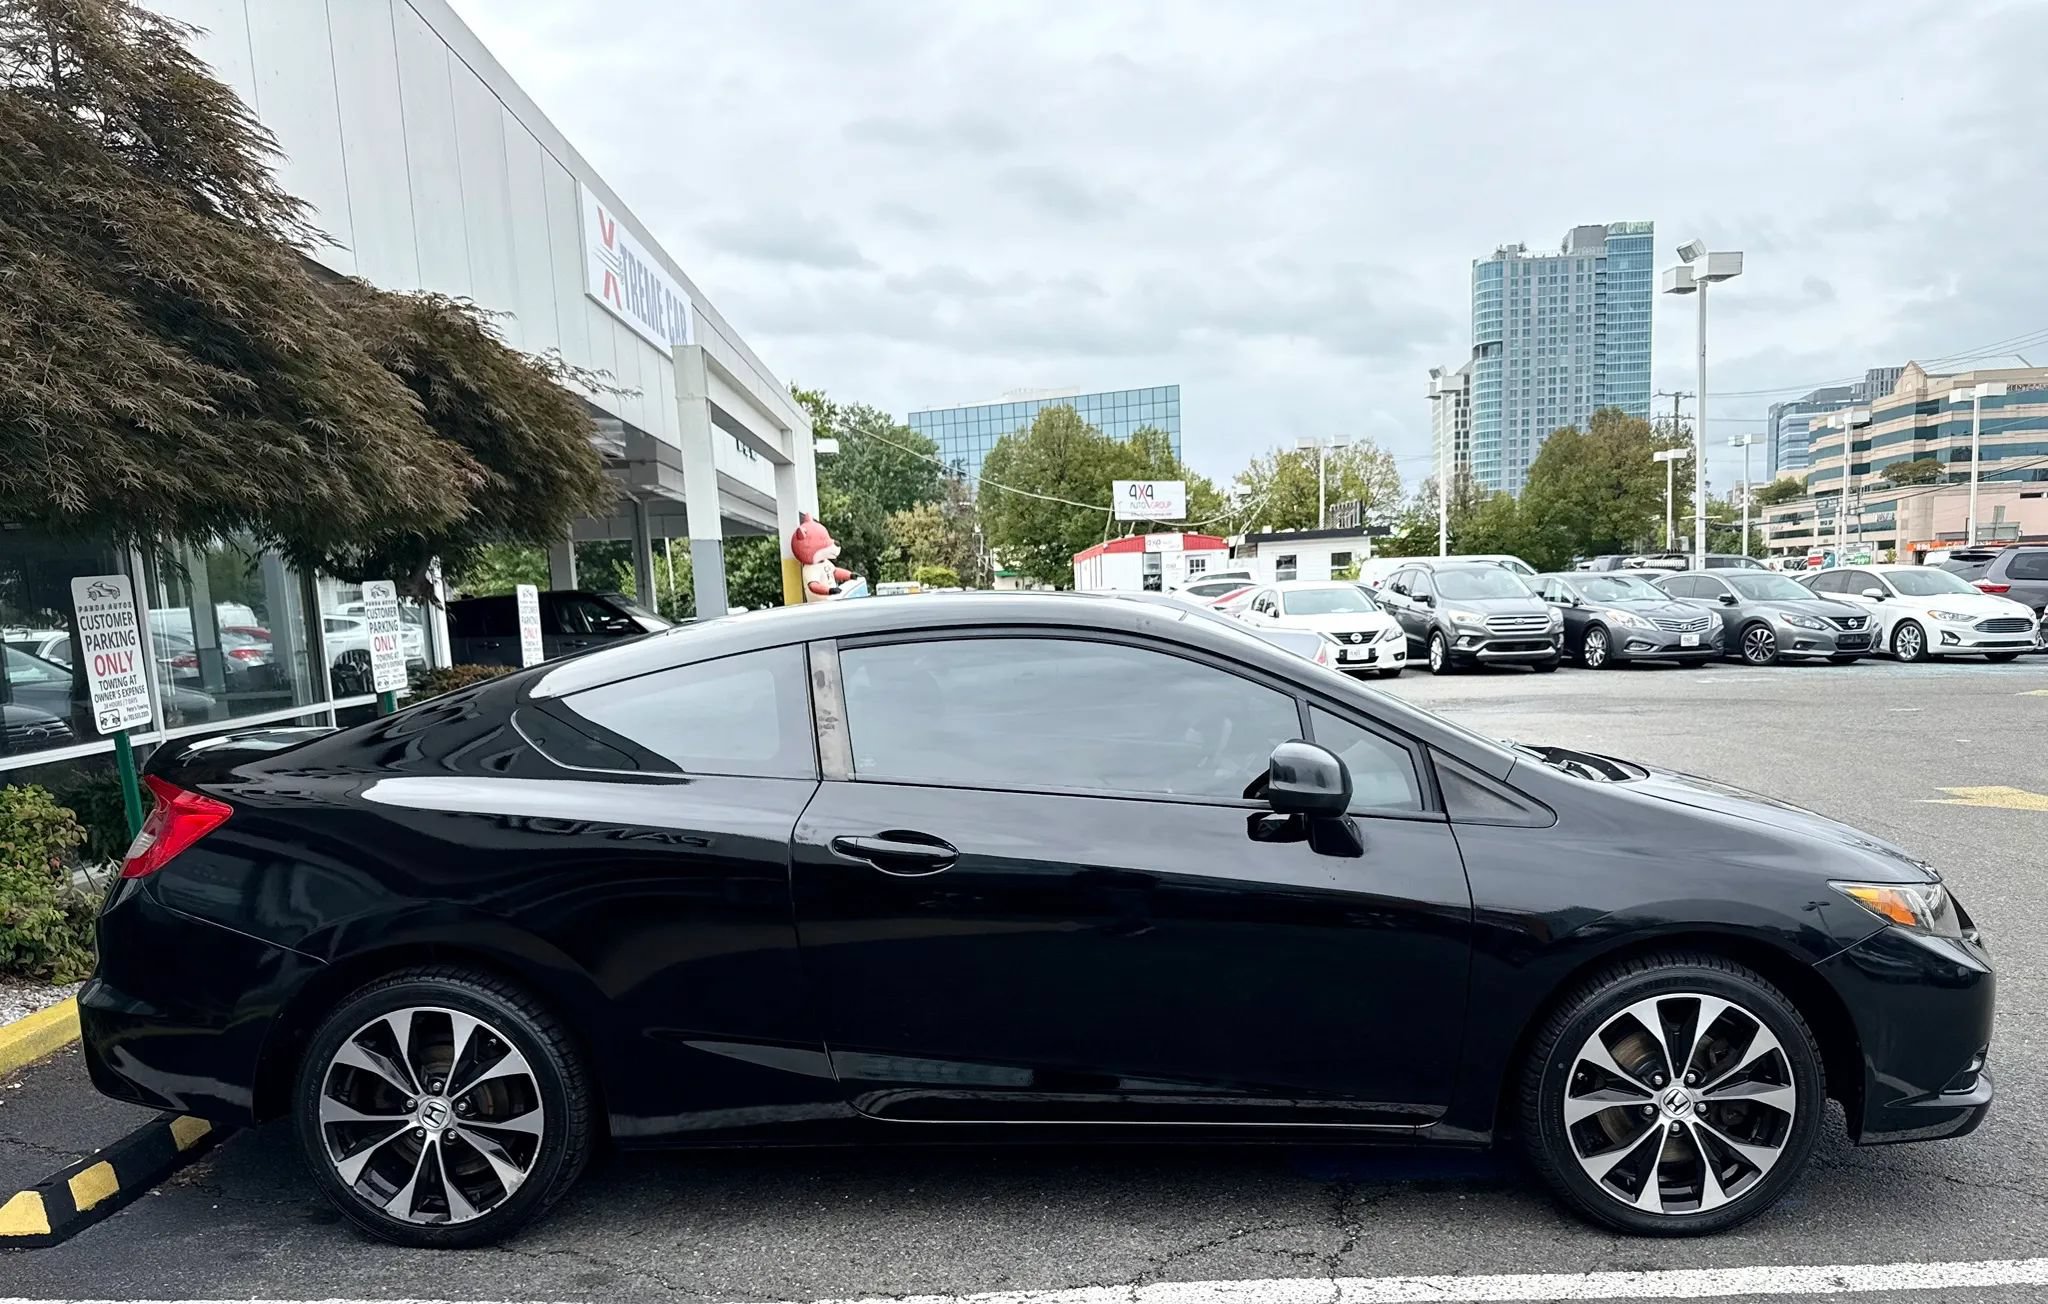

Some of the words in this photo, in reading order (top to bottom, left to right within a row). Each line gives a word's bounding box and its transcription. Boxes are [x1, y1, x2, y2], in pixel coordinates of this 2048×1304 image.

[665, 287, 688, 346] CAR
[78, 604, 105, 613] PANDA
[108, 601, 132, 610] AUTOS
[366, 606, 397, 619] CUSTOMER
[79, 611, 135, 631] CUSTOMER
[369, 619, 399, 634] PARKING
[85, 629, 136, 652] PARKING
[374, 633, 397, 652] ONLY
[94, 650, 133, 677] ONLY
[98, 676, 128, 691] TOWING
[129, 675, 137, 685] AT
[94, 689, 121, 703] OWNER'S
[121, 685, 146, 698] EXPENSE
